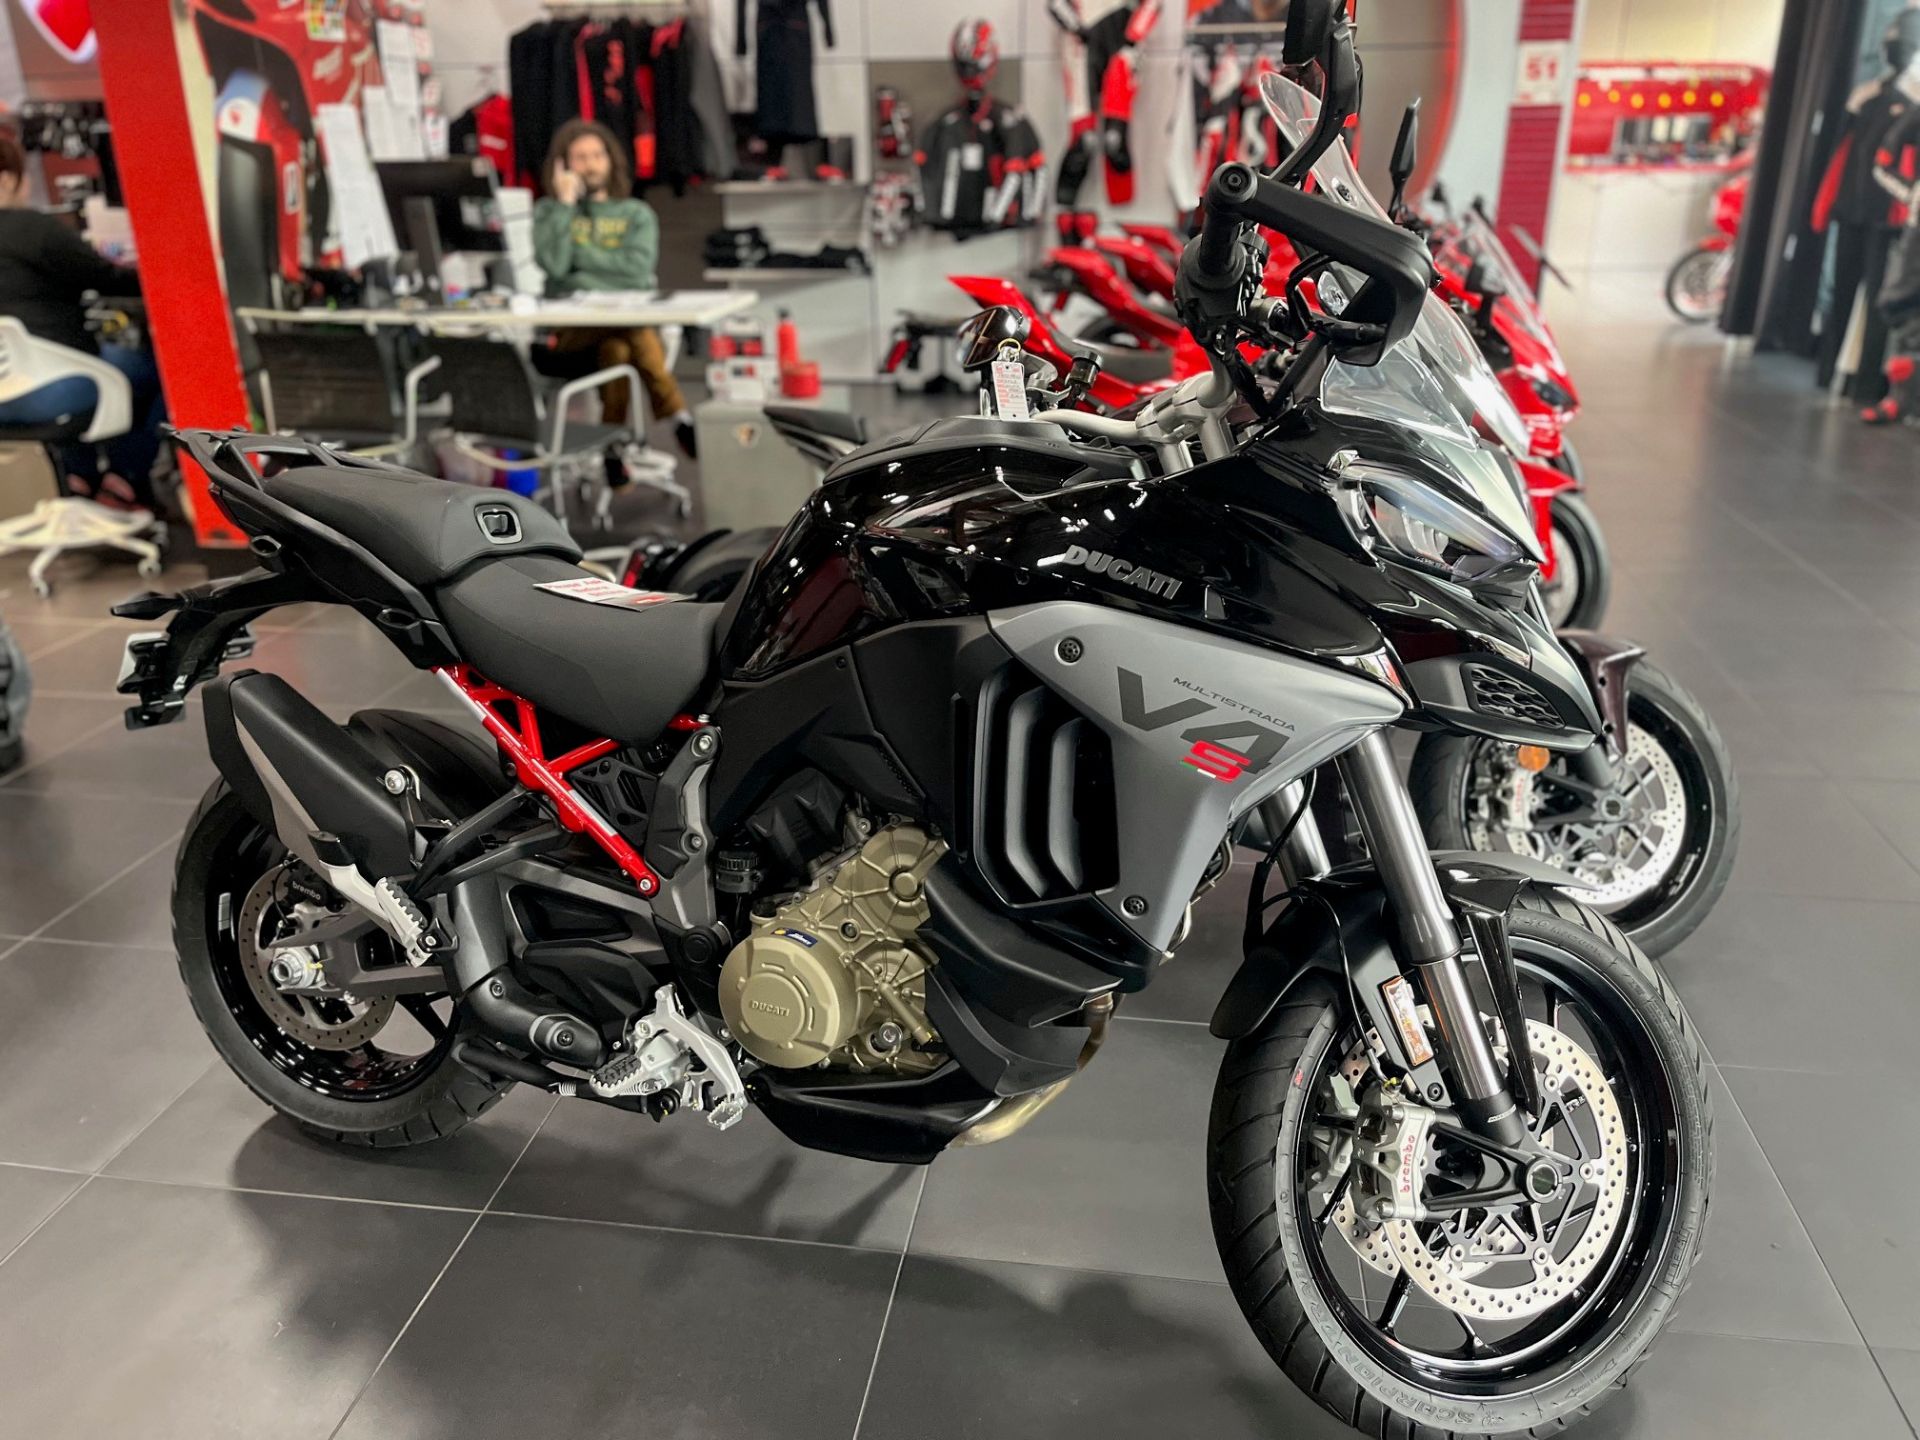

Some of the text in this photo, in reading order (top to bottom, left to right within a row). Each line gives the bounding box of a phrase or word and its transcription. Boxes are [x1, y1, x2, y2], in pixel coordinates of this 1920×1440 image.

[1062, 544, 1183, 600] DUCATI
[1173, 677, 1296, 732] MULTISTRADA
[292, 880, 321, 900] brembo
[749, 1000, 790, 1017] DUCATI
[1400, 1134, 1416, 1193] brembo
[1335, 1346, 1475, 1425] SCORPION
